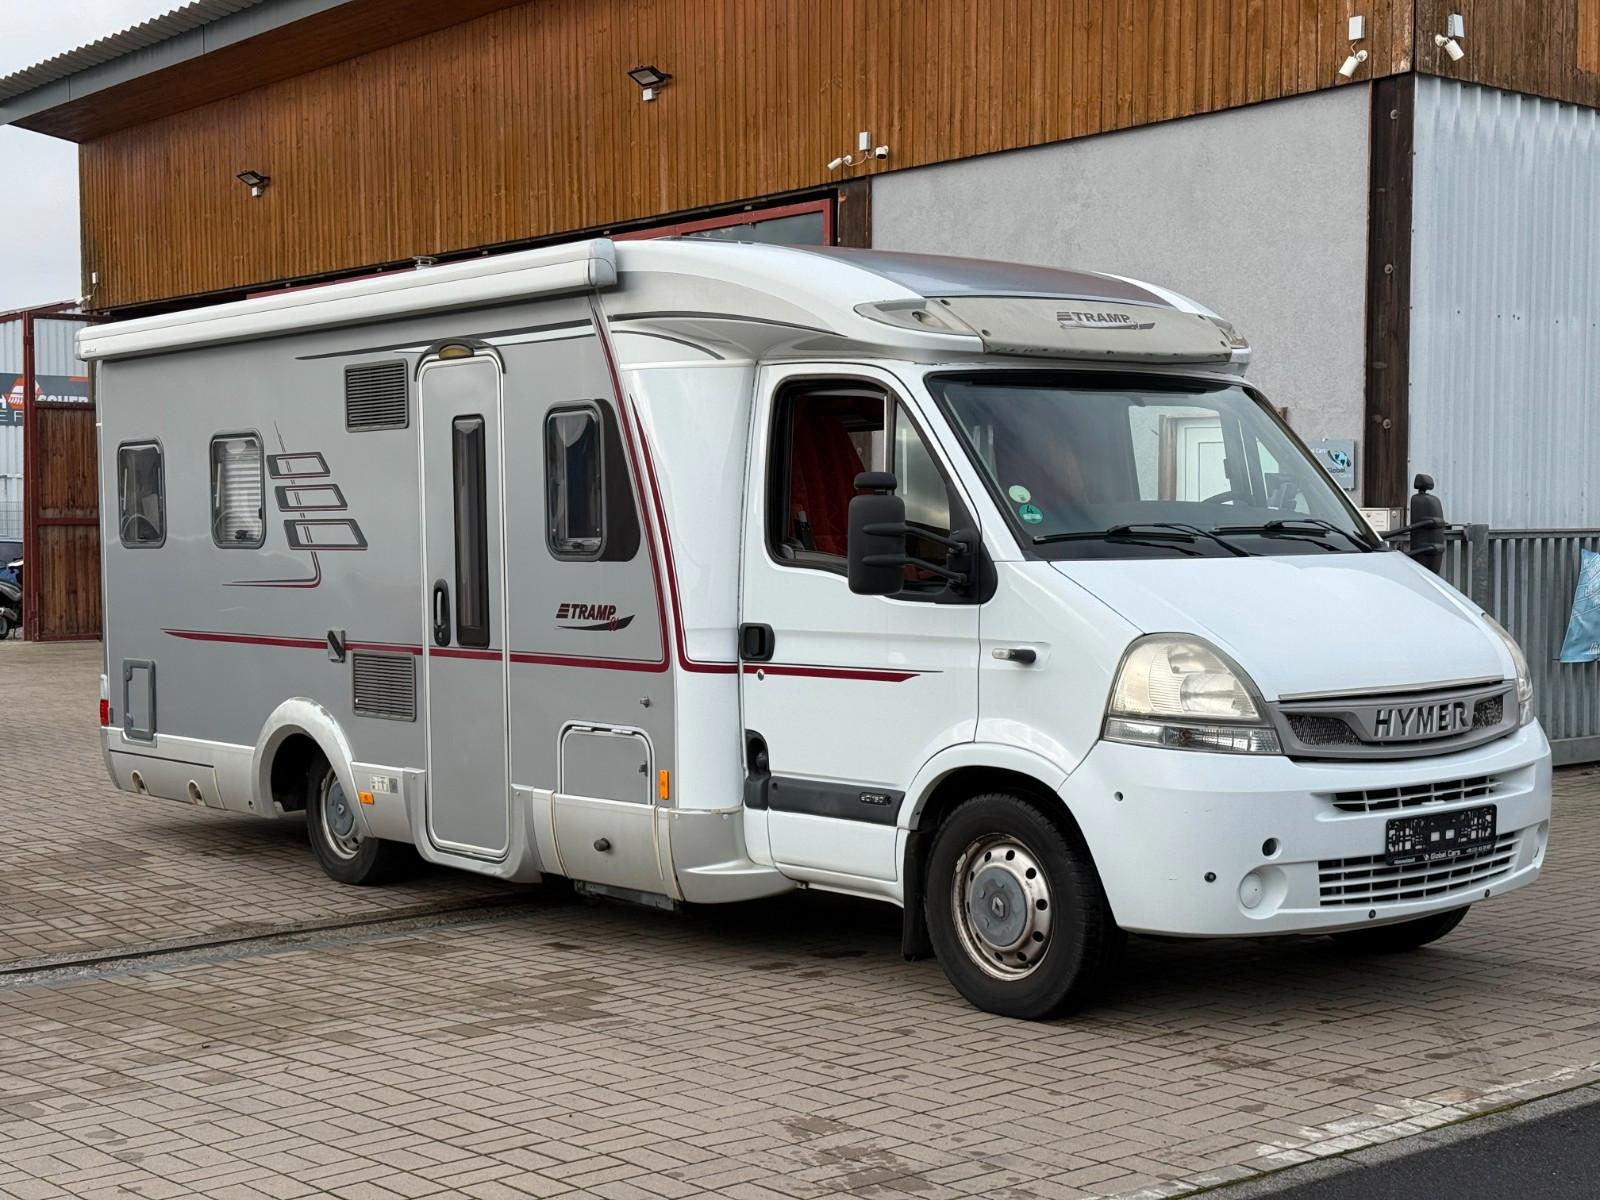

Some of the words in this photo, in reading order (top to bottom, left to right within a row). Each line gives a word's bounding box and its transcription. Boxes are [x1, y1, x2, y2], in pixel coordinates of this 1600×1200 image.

[1071, 311, 1130, 323] TRAMP
[571, 603, 617, 621] TRAMP
[1374, 701, 1470, 737] HYMER
